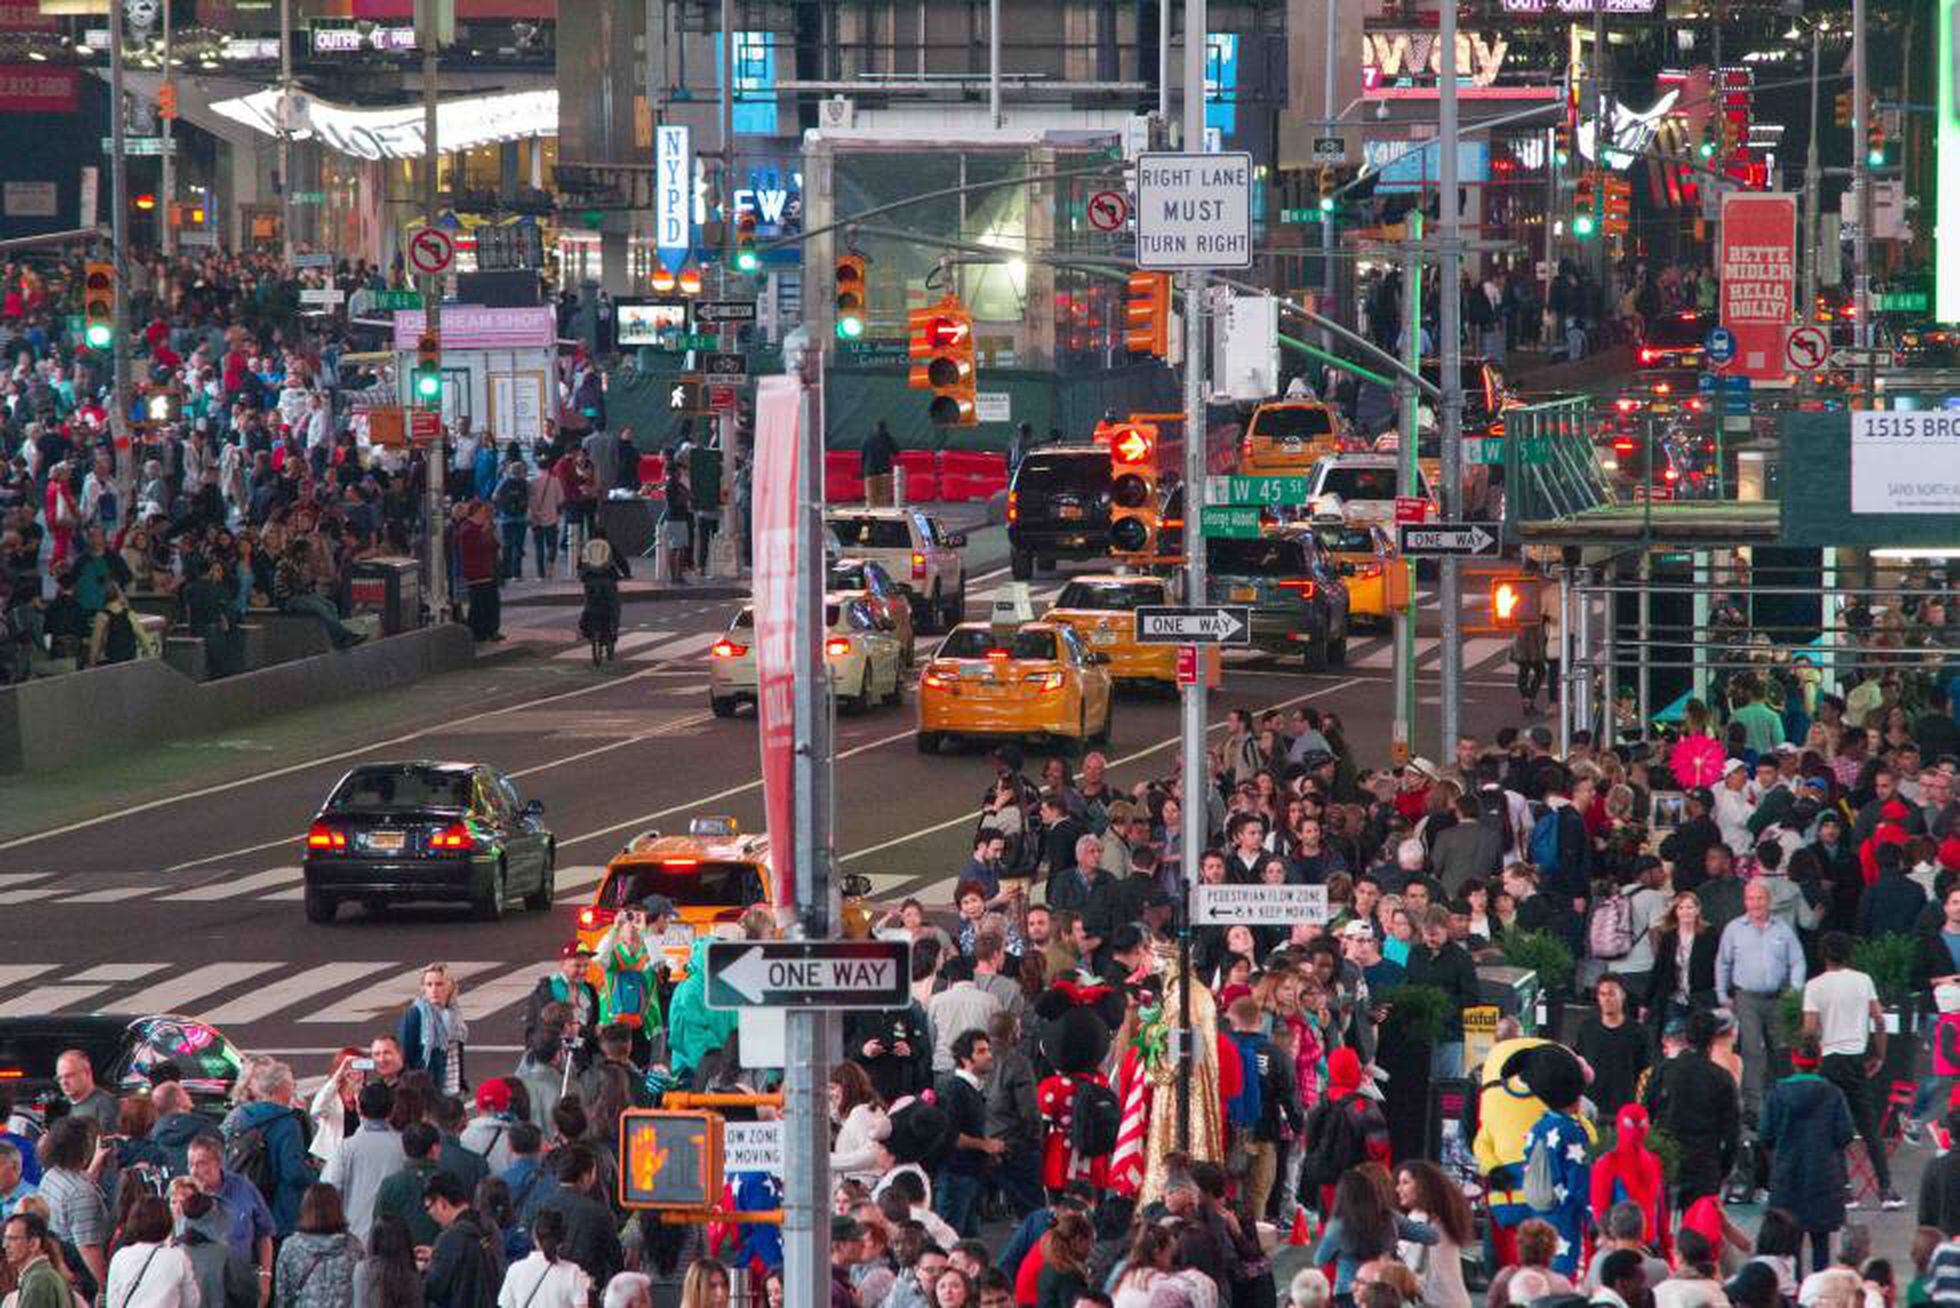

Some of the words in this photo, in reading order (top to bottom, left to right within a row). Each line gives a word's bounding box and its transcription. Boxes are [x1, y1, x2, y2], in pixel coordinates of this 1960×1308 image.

[1142, 169, 1191, 186] RIGHT
[1202, 169, 1246, 186] LANE
[665, 131, 681, 243] NYPD
[1164, 200, 1223, 221] MUST
[1141, 235, 1185, 252] TURN
[1197, 235, 1246, 252] RIGHT
[1728, 245, 1790, 262] BETTE
[1725, 264, 1792, 280] MIDLER
[441, 313, 487, 330] REAM
[493, 312, 543, 330] SHOP
[1865, 418, 1915, 437] 1515
[1233, 480, 1250, 501] W
[1259, 480, 1280, 501] 45
[1414, 534, 1441, 546] ONE
[1456, 534, 1485, 546] WAY
[1152, 618, 1184, 632] ONE
[1199, 618, 1231, 632] WAY
[1208, 890, 1265, 901] PEDESTRIAN
[1269, 890, 1292, 901] FLOW
[1298, 890, 1320, 901] ZONE
[1259, 906, 1281, 917] KEEP
[1286, 905, 1322, 917] MOVING
[769, 962, 822, 986] ONE
[832, 962, 888, 986] WAY
[749, 1129, 778, 1142] ZONE
[735, 1149, 781, 1163] MOVING
